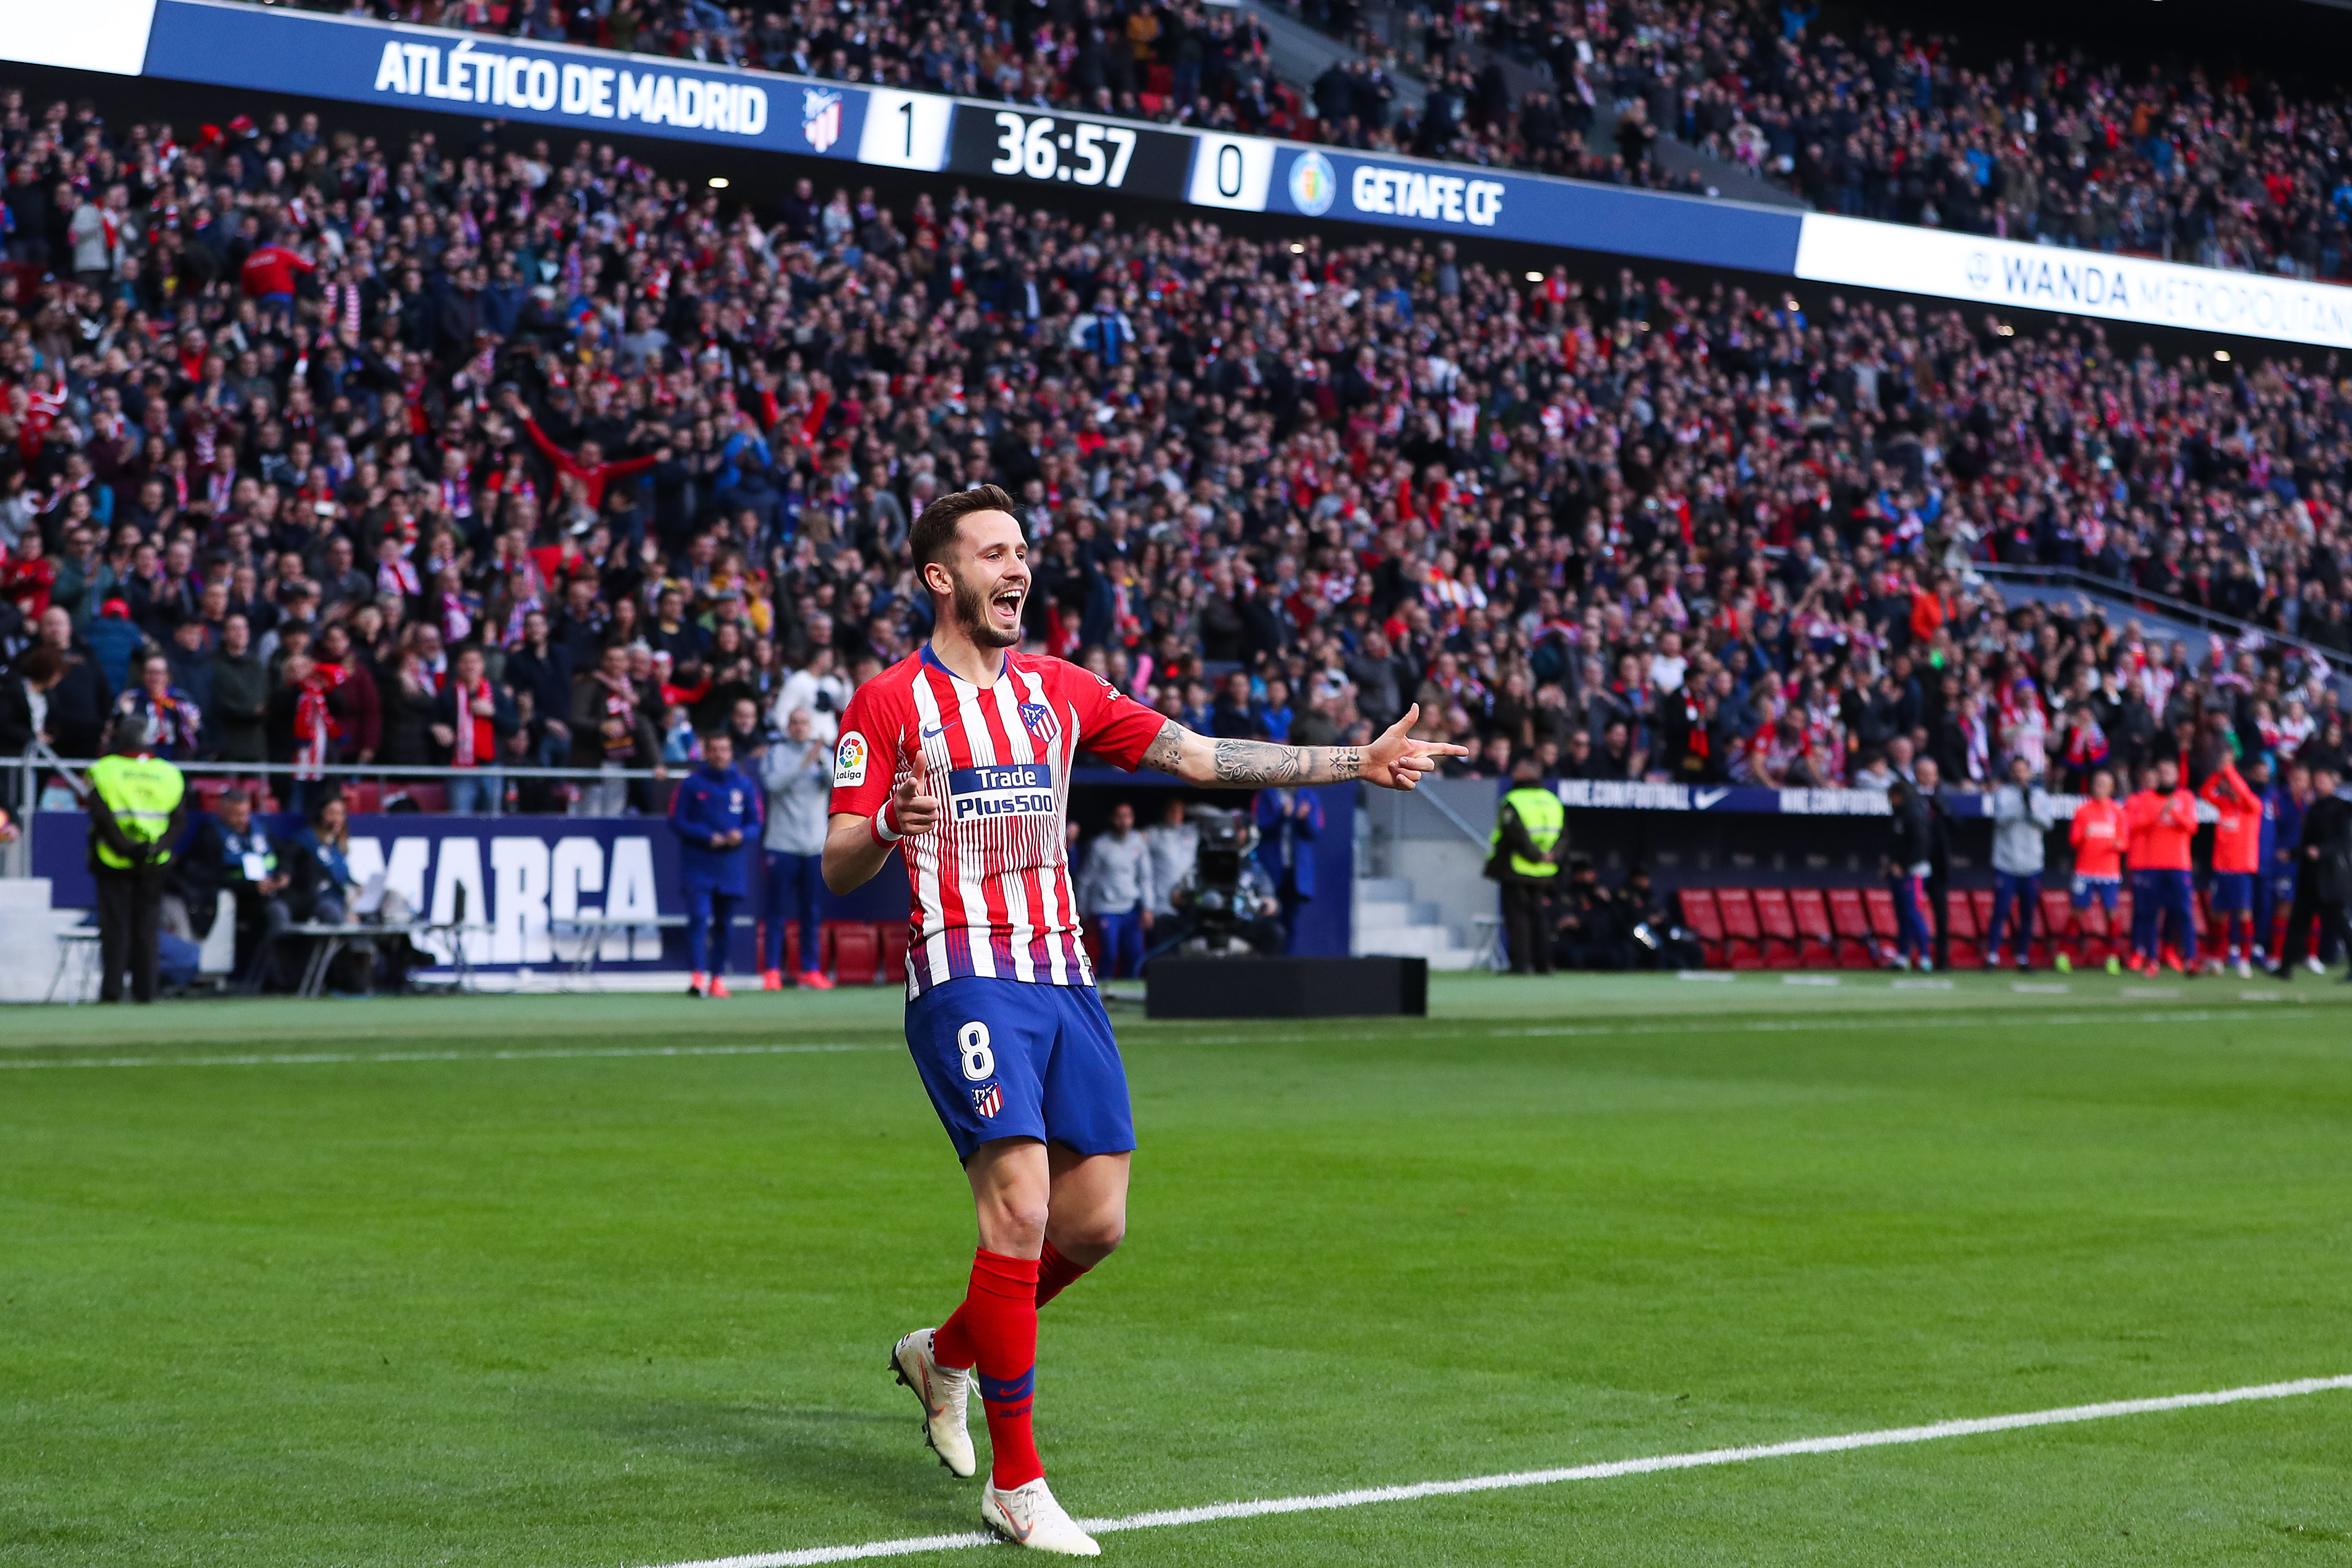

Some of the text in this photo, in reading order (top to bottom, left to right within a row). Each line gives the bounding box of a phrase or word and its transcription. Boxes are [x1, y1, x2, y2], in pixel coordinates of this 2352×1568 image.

[374, 40, 768, 136] ATLÉTICO DE MADRID
[899, 101, 913, 158] 1
[991, 111, 1137, 188] 36:57
[1217, 144, 1243, 198] 0
[1352, 165, 1505, 226] GETAFE CF
[2001, 254, 2352, 338] WANDA METROPOLITAN
[836, 770, 861, 780] LaLiga
[975, 766, 1036, 788] Trade
[956, 794, 1053, 819] Plus500
[345, 836, 663, 966] MARCA
[958, 1021, 996, 1081] 8
